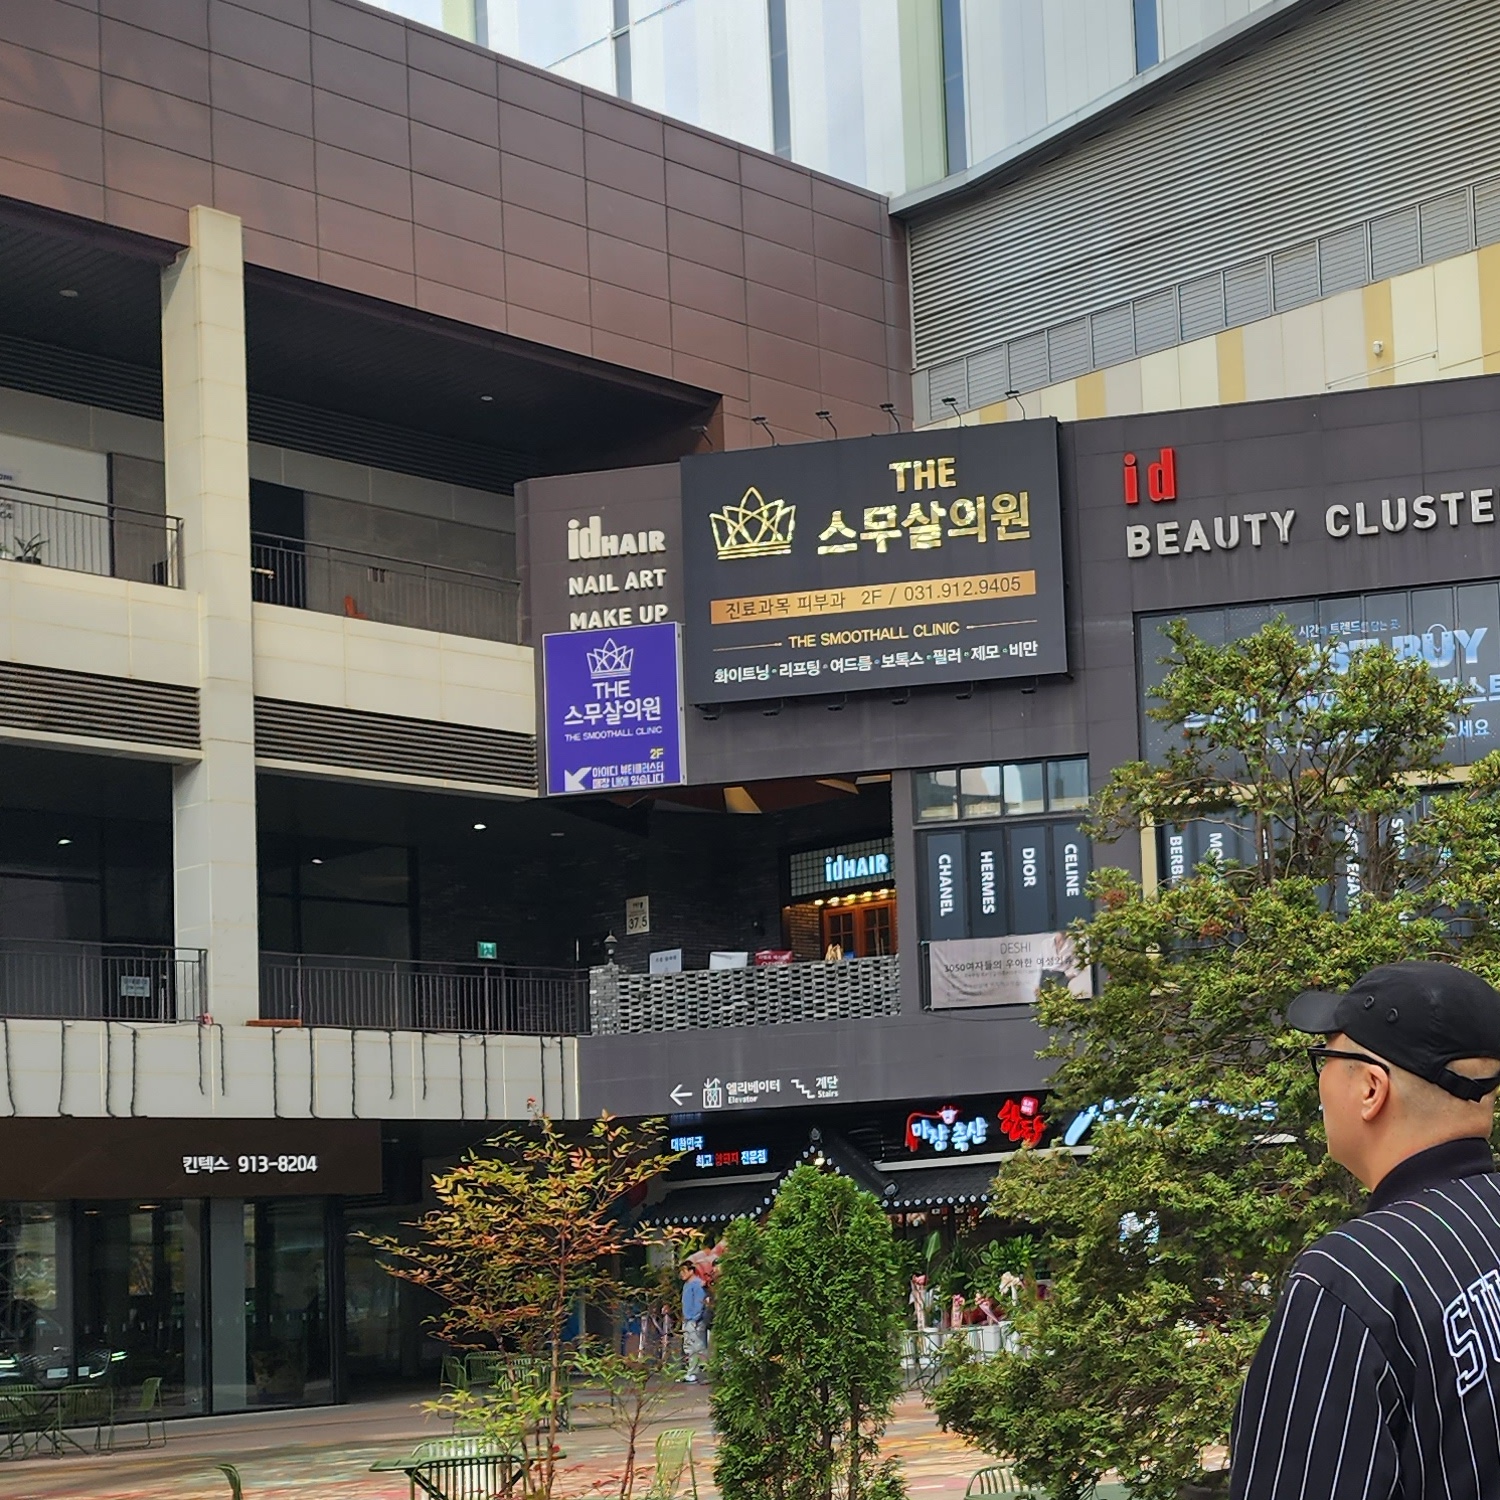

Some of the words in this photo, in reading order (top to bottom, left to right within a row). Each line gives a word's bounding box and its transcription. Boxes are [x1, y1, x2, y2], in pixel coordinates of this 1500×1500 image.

[889, 457, 957, 492] THE
[1124, 447, 1176, 504] id
[817, 491, 1031, 554] 스무살의원
[1126, 509, 1296, 558] BEAUTY
[568, 574, 620, 596] NAIL
[624, 568, 667, 590] ART
[726, 598, 791, 620] 진료과목
[797, 591, 846, 612] 피부과
[860, 589, 882, 605] 2F
[904, 576, 1021, 601] 031.912.9405
[569, 607, 633, 631] MAKE
[639, 604, 669, 624] UP
[788, 634, 817, 649] THE
[820, 626, 909, 647] SMOOTHALL
[912, 621, 960, 639] CLINIC
[713, 664, 770, 684] 화이트닝
[779, 659, 821, 678] 리프팅
[881, 651, 925, 669] 보톡스
[932, 647, 962, 665] 필러
[971, 644, 1000, 661] 제모
[1008, 640, 1039, 657] 비만
[592, 680, 631, 699] THE
[563, 696, 661, 726] 스무살의원
[565, 733, 581, 742] THE
[583, 729, 634, 741] SMOOTHALL
[635, 726, 663, 736] CLINIC
[650, 747, 664, 760] 2F
[592, 765, 618, 778] 아이디
[1022, 847, 1037, 888] DIOR
[1064, 843, 1080, 898] CELINE
[937, 853, 954, 917] CHANEL
[980, 850, 996, 915] HERMES
[1000, 942, 1031, 955] DESHI
[725, 1079, 781, 1096] 엘리베이터
[815, 1075, 839, 1090] 계단
[727, 1094, 759, 1105] Elevator
[817, 1088, 839, 1099] Stairs
[182, 1155, 231, 1173] 킨텍스
[237, 1154, 319, 1173] 913-8204
